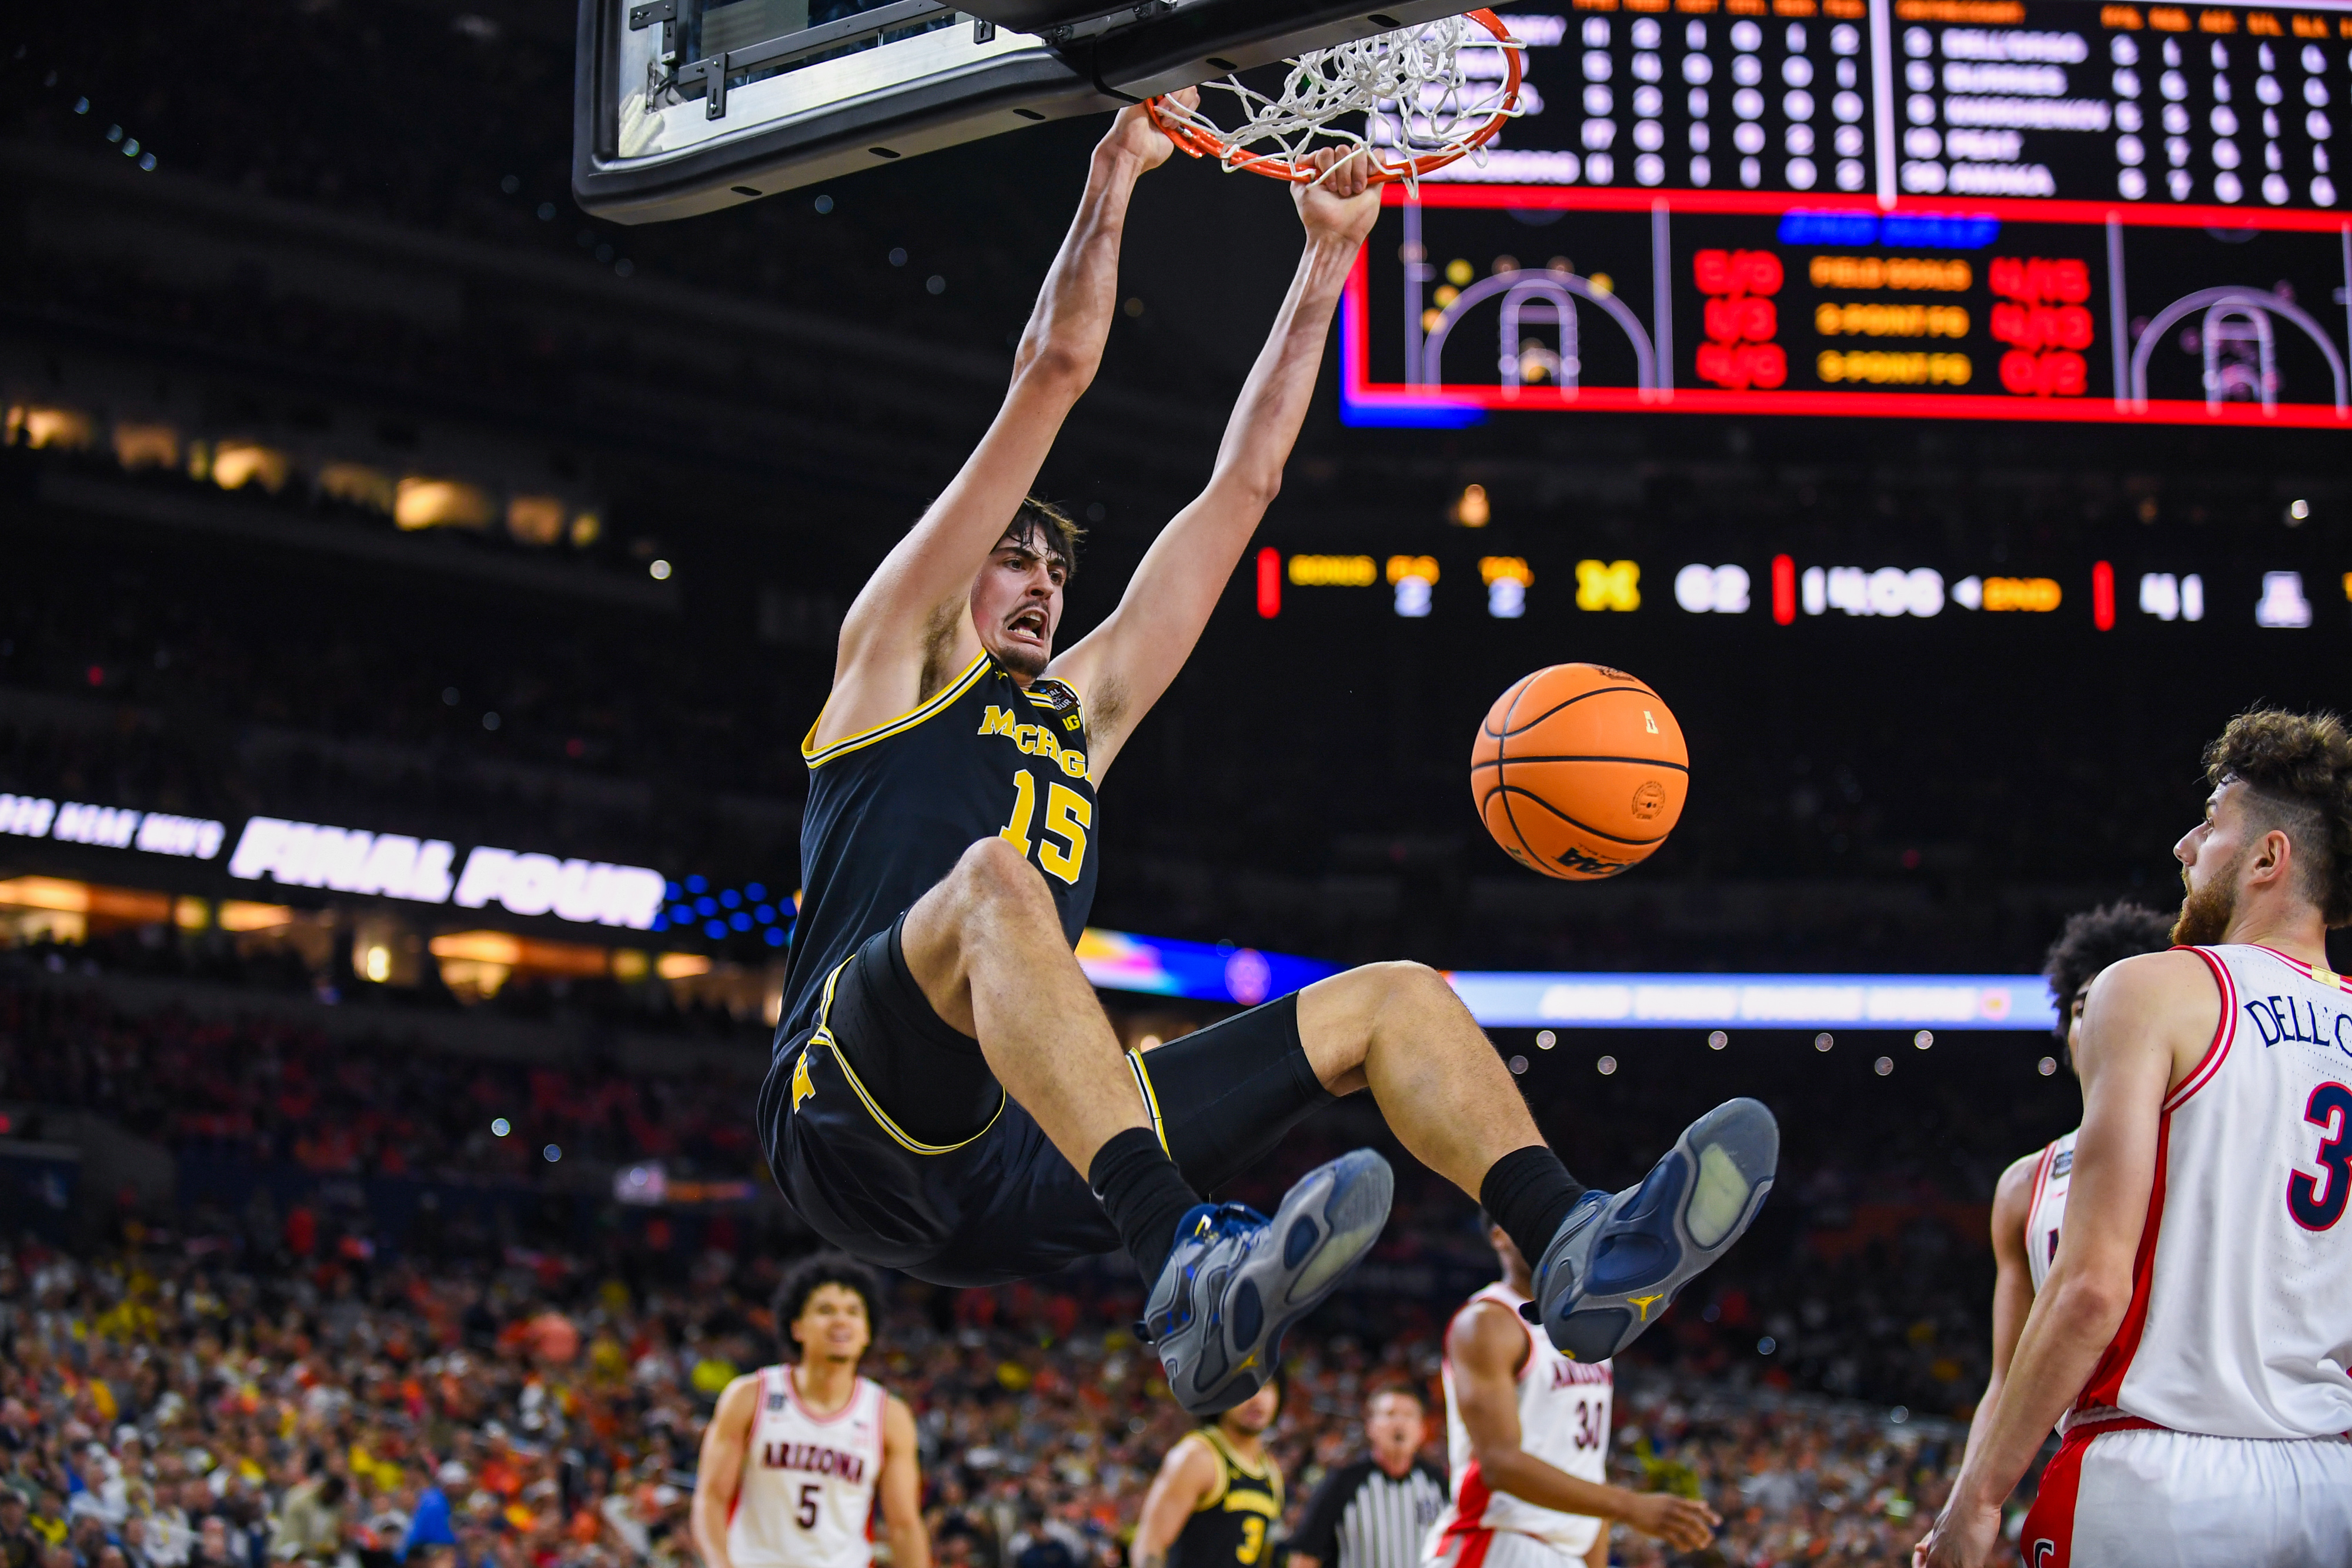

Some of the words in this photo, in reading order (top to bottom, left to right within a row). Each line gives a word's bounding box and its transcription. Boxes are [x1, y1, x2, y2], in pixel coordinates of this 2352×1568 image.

[999, 768, 1092, 885] 15
[229, 815, 456, 904] FINAL
[453, 845, 667, 931] FOUR
[2286, 1081, 2352, 1232] 3
[763, 1442, 865, 1484] ARIZONA
[797, 1485, 820, 1529] 5
[1236, 1515, 1267, 1565] 3
